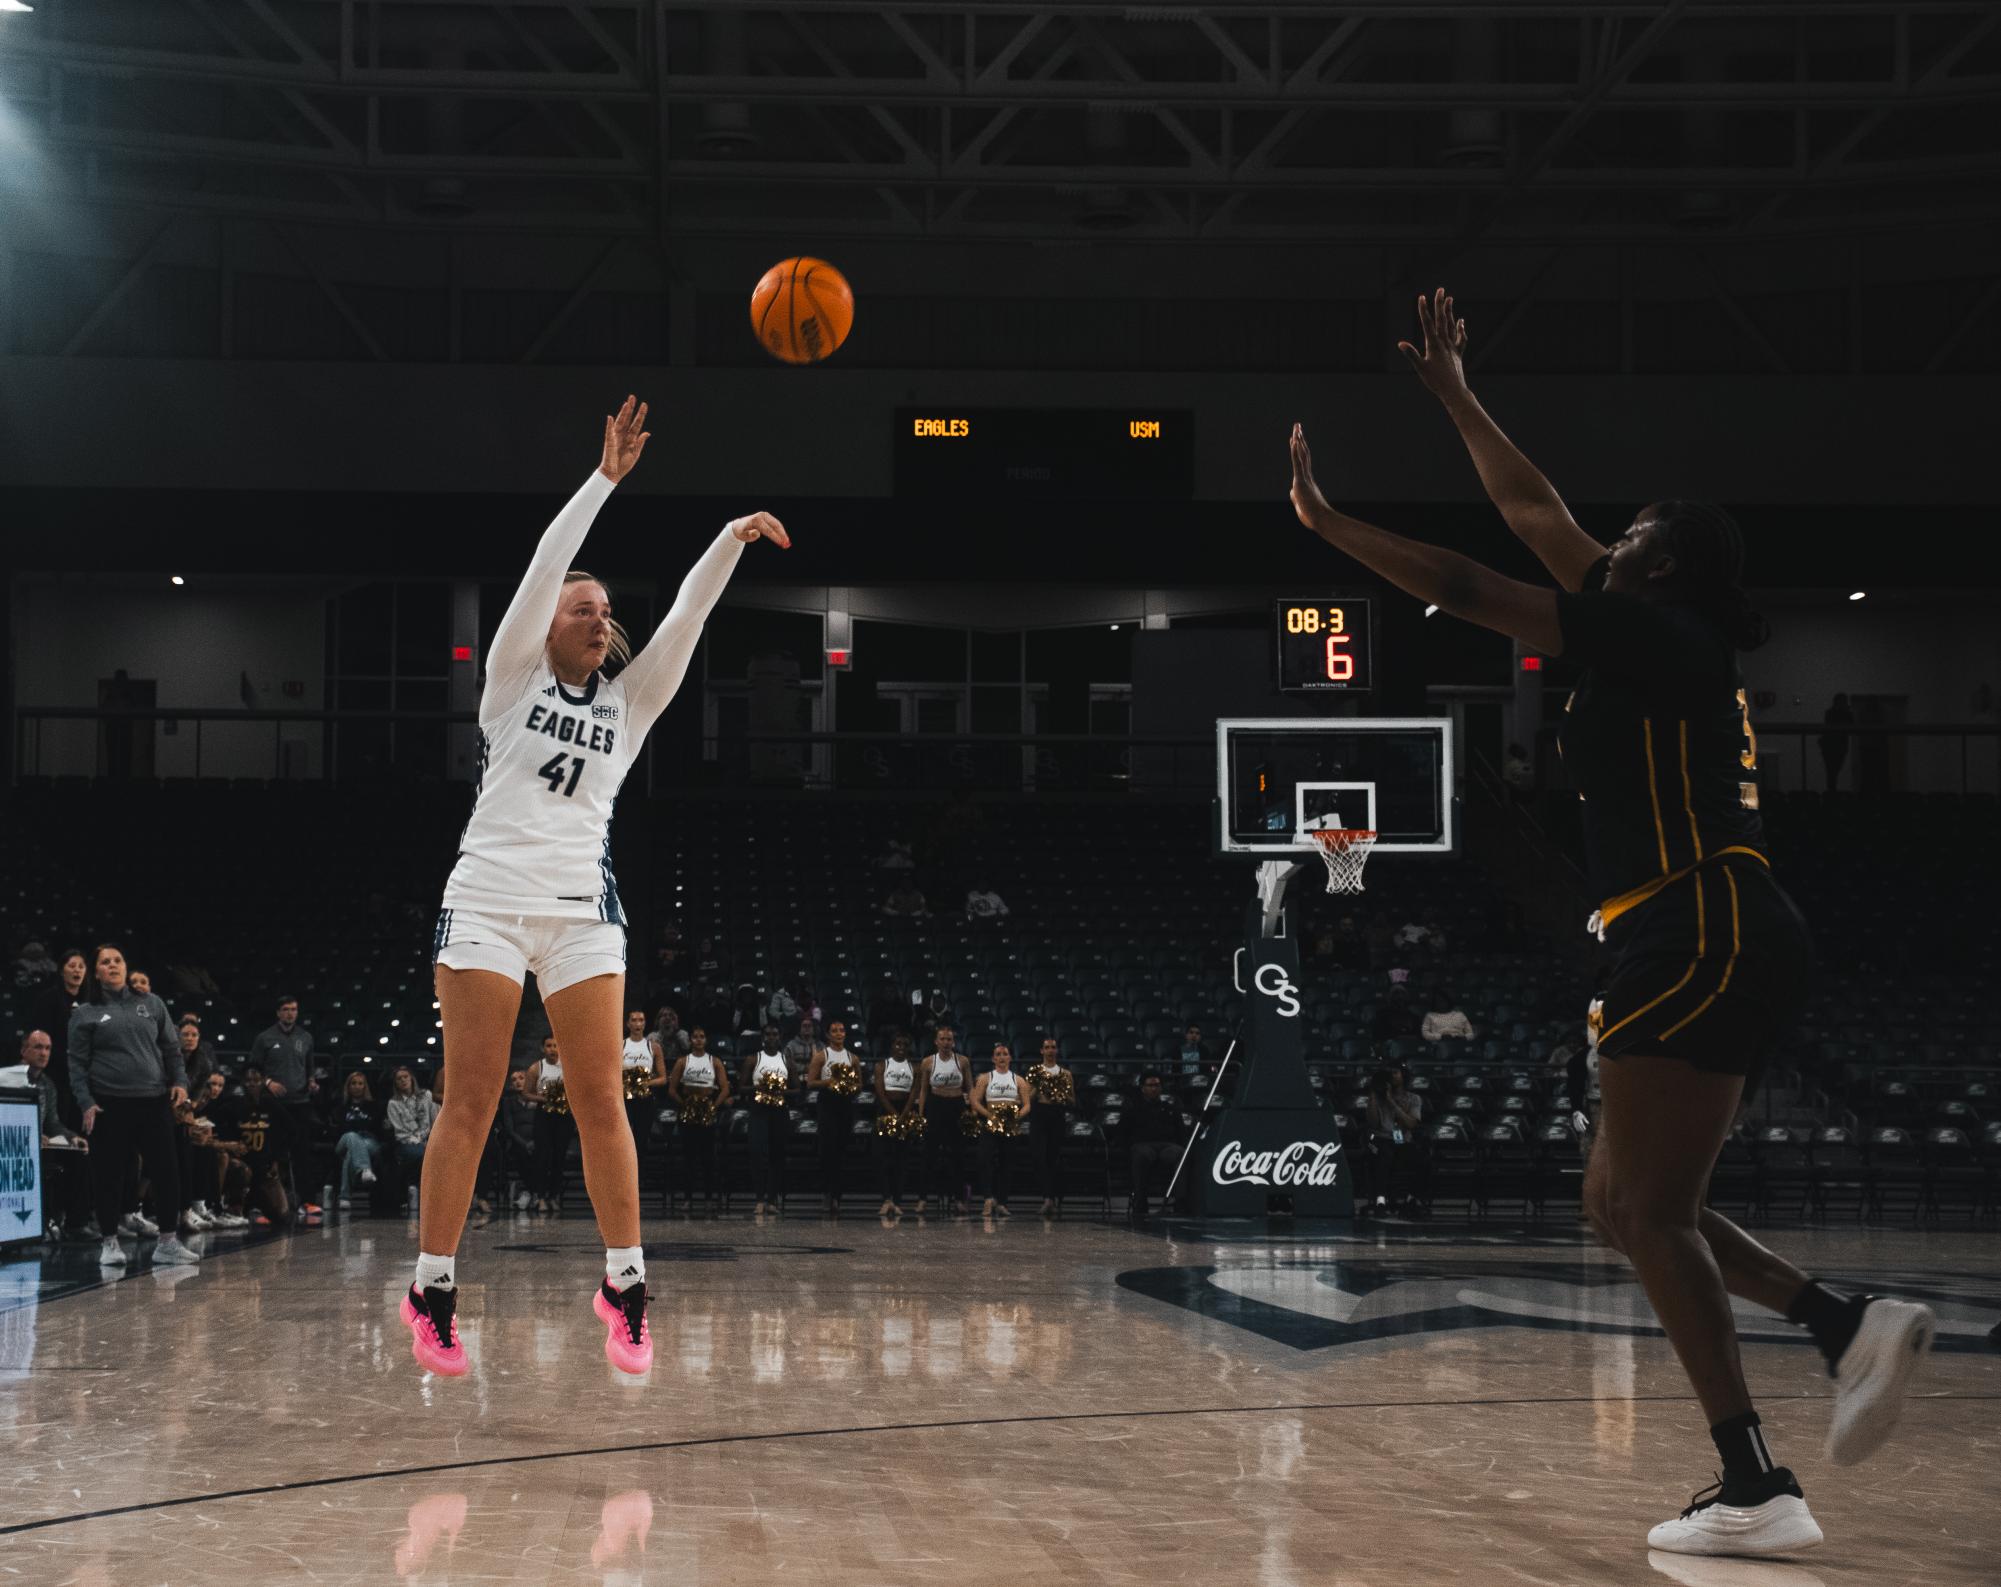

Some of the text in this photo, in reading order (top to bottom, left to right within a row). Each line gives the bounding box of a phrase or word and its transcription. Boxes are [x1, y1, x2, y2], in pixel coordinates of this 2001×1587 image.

[914, 419, 969, 437] EAGLES
[1129, 421, 1160, 439] USM
[1287, 608, 1344, 633] 08.3
[1327, 635, 1353, 680] 6
[526, 704, 615, 755] EAGLES
[592, 705, 618, 720] SBC
[538, 752, 586, 797] 41
[1255, 963, 1300, 1017] GS
[12, 1158, 35, 1193] HEAD
[1212, 1140, 1342, 1186] Coca-Cola
